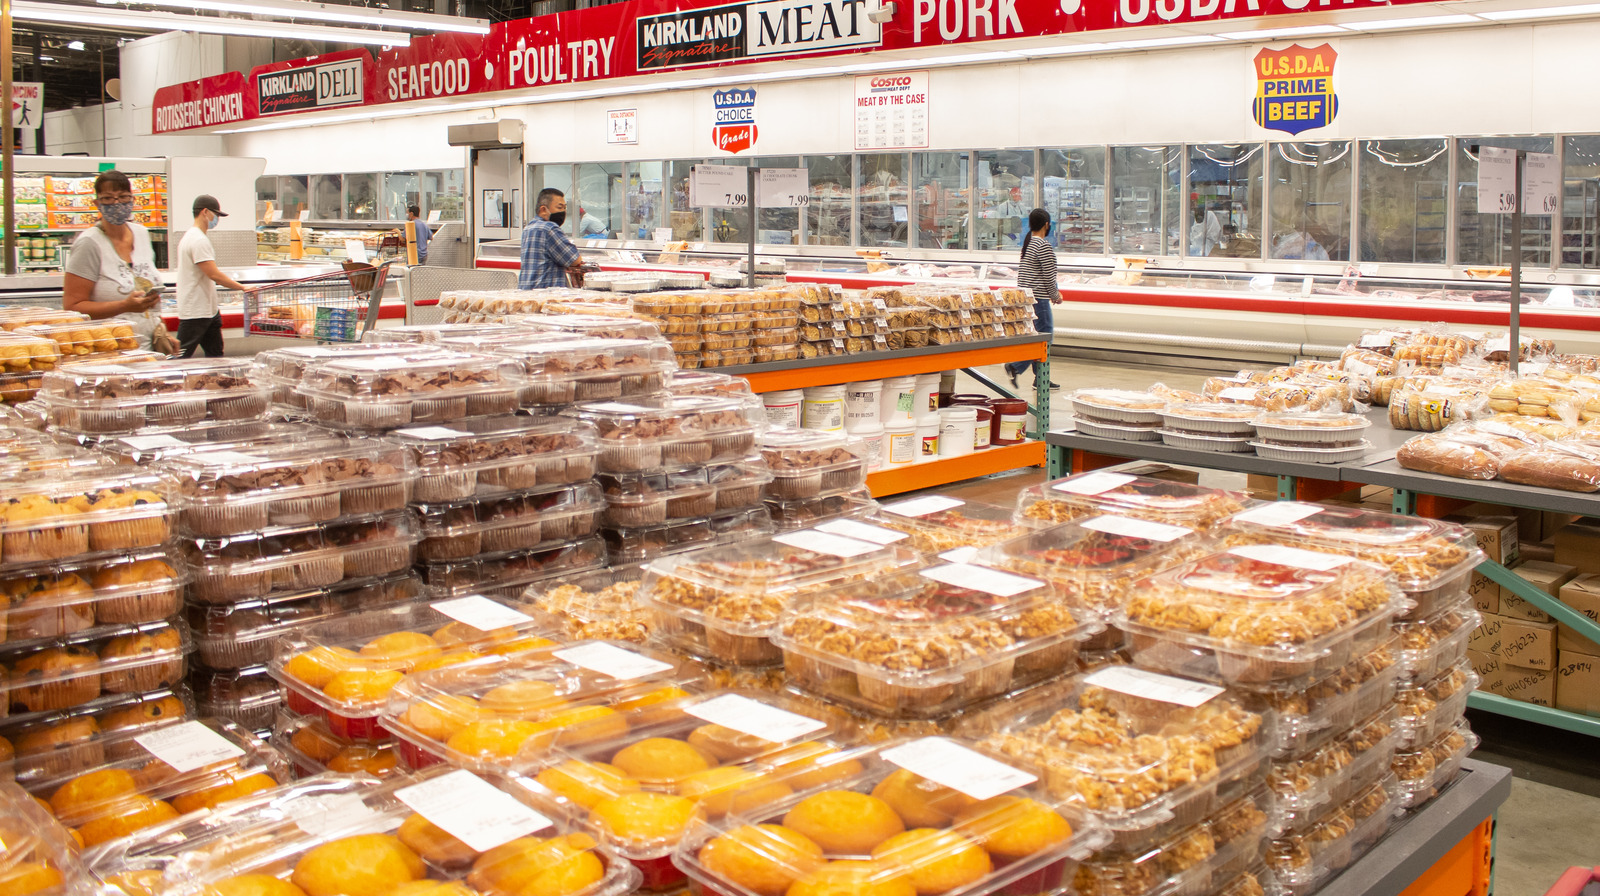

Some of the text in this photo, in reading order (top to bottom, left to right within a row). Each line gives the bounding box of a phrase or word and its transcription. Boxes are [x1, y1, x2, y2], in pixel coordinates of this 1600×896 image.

[643, 12, 742, 47] KIRKLAND
[757, 0, 866, 47] MEAT
[913, 0, 1024, 43] PORK
[509, 36, 615, 86] POULTRY
[643, 42, 741, 67] Signature
[1261, 54, 1330, 76] U.S.D.A.
[261, 71, 316, 97] KIRKLAND
[319, 66, 357, 100] DELI
[388, 58, 470, 101] SEAFOOD
[1264, 78, 1327, 95] PRIME
[262, 94, 314, 112] Signature
[716, 92, 754, 106] U.S.D.A.
[857, 93, 925, 107] MEAT BY THE CASE
[156, 92, 244, 132] ROTISSERIE CHICKEN
[716, 108, 752, 121] CHOICE
[1268, 100, 1321, 121] BEEF
[721, 129, 749, 149] Grade
[725, 193, 747, 206] 7.99
[788, 195, 809, 206] 7.99
[1499, 193, 1515, 211] 5.99
[1543, 195, 1557, 212] 6.99
[1476, 534, 1495, 550] 596
[1502, 632, 1538, 660] 1056231
[1504, 671, 1546, 696] 1440863
